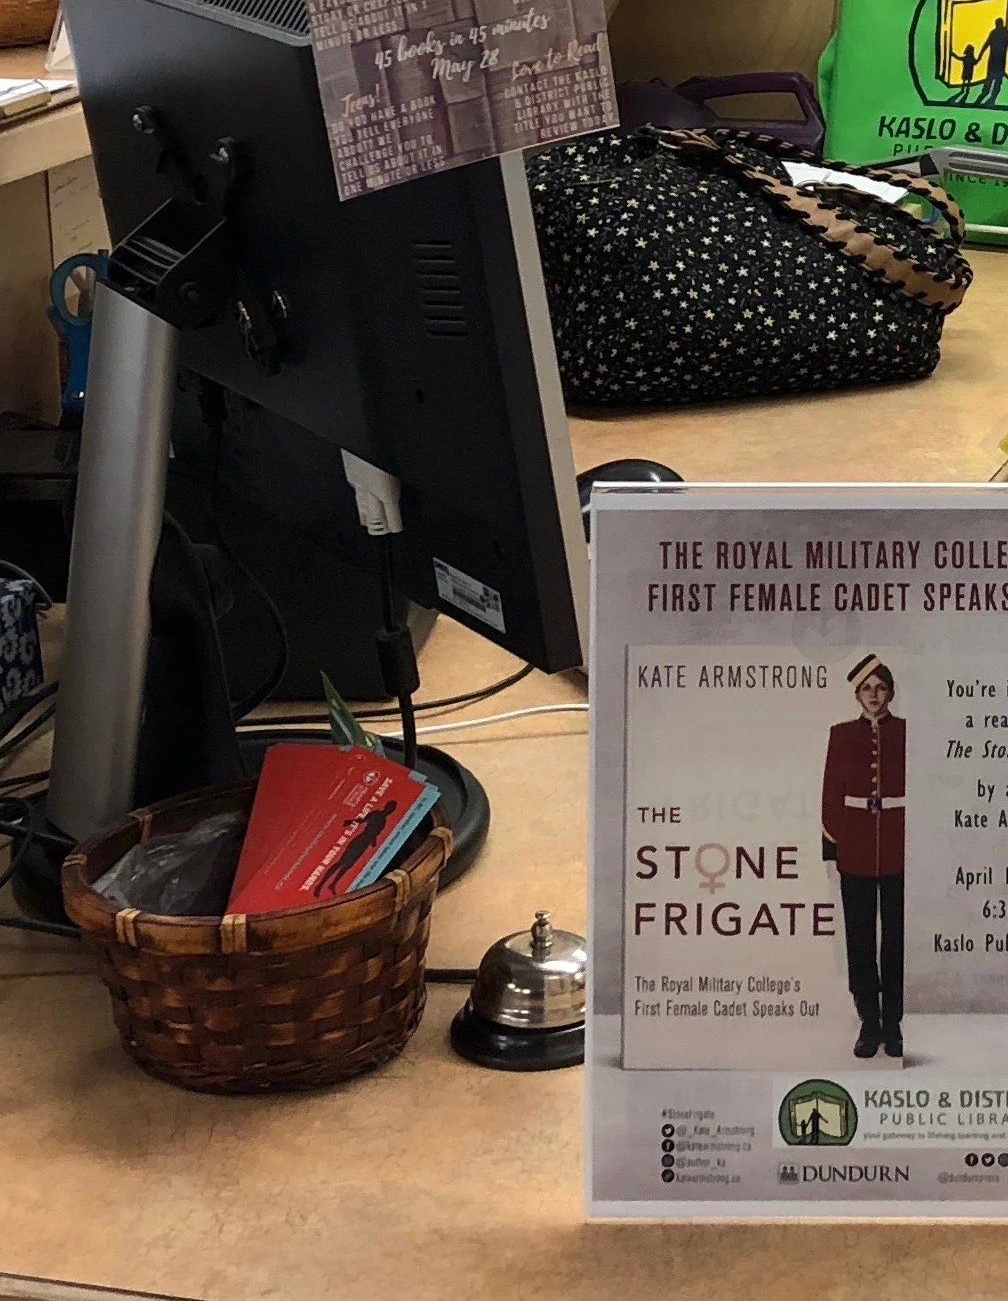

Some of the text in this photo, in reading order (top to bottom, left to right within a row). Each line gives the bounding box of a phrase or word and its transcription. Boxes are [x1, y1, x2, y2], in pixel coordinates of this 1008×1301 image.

[374, 7, 550, 70] 45 books in 45 minutes
[430, 47, 500, 82] May 28
[878, 115, 957, 141] KASLO
[964, 121, 983, 143] &
[659, 541, 703, 570] THE
[716, 541, 793, 570] ROYAL
[805, 541, 920, 570] MILITARY
[647, 583, 716, 613] FIRST
[729, 583, 821, 613] FEMALE
[834, 583, 911, 613] CADET
[637, 665, 829, 690] KATE ARMSTRONG
[946, 679, 996, 698] You're
[965, 715, 974, 728] a
[946, 740, 972, 759] The
[977, 779, 995, 802] by
[638, 807, 681, 824] THE
[954, 810, 988, 828] Kate
[636, 843, 799, 894] STONE
[955, 866, 993, 890] April
[634, 902, 836, 937] FRIGATE
[934, 934, 974, 953] Kaslo
[635, 976, 801, 995] The Royal Military College's
[634, 1000, 820, 1019] First Female Cadet Speaks Out
[864, 1090, 930, 1109] KASLO
[938, 1091, 951, 1109] &
[880, 1112, 947, 1126] PUBLIC
[802, 1164, 911, 1183] DUNDURN
